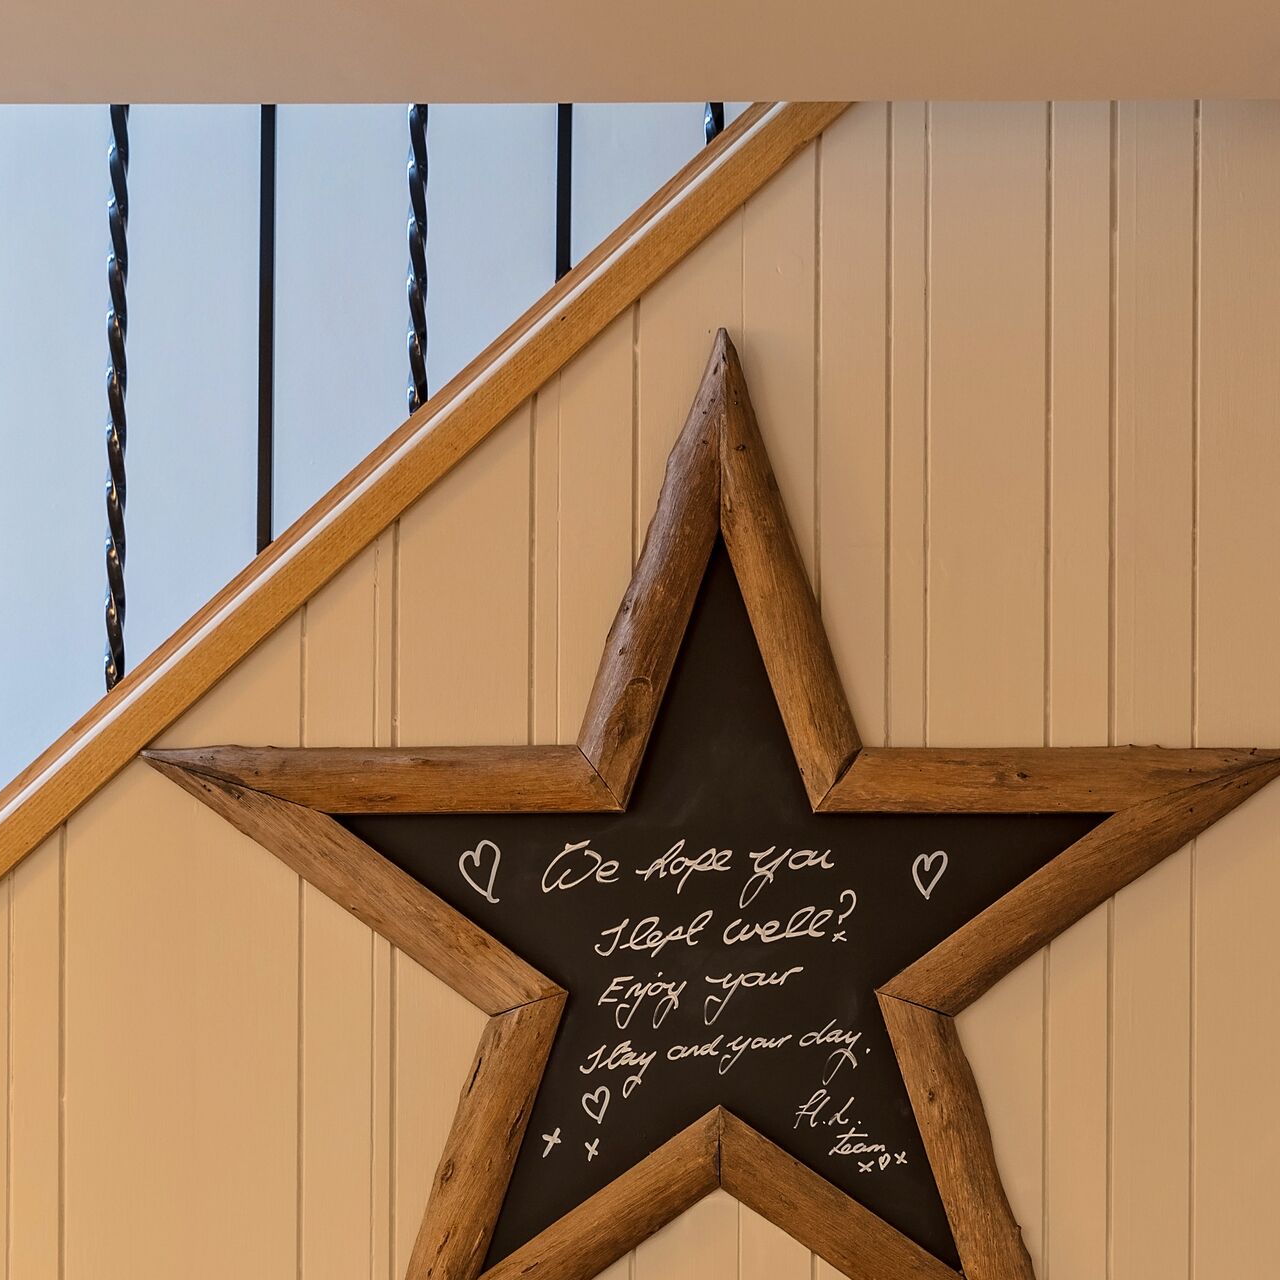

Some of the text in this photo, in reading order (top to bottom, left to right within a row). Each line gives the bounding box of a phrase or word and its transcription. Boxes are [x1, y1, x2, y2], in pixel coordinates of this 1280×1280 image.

[541, 839, 834, 908] We hope you
[598, 966, 804, 1029] Enjoy your
[666, 1034, 724, 1061] and
[720, 1033, 793, 1075] your
[828, 1127, 886, 1156] team
